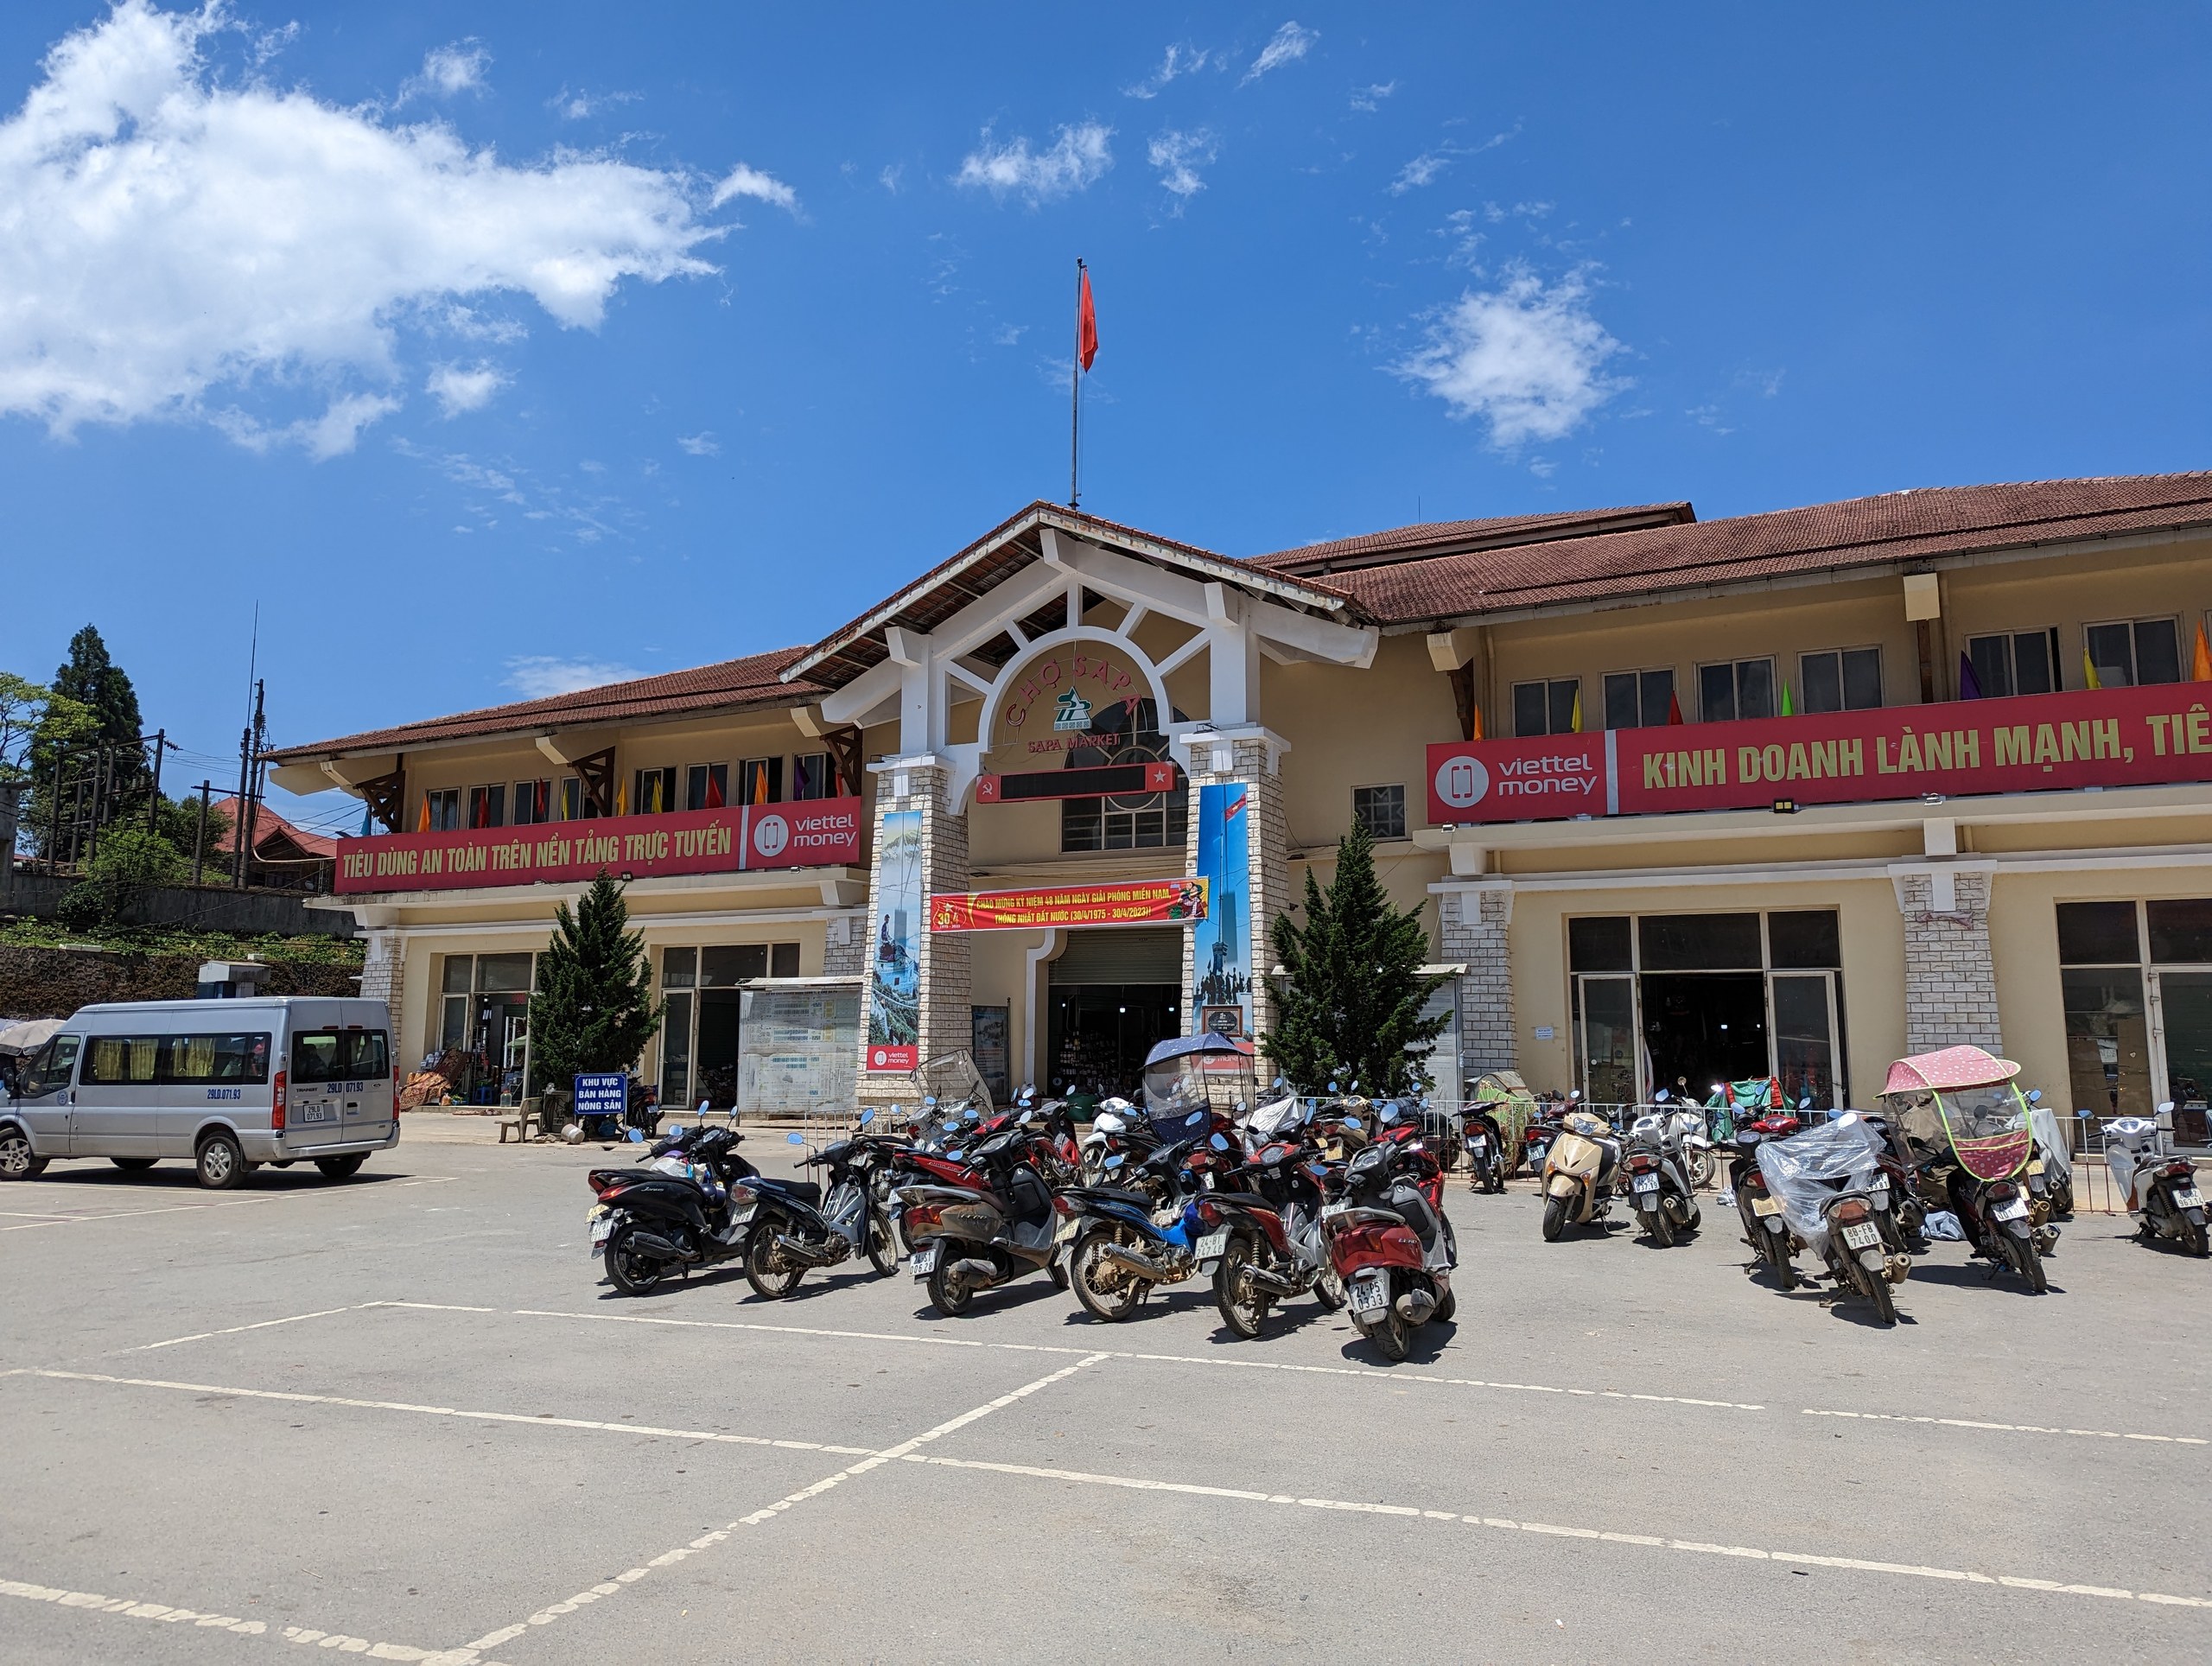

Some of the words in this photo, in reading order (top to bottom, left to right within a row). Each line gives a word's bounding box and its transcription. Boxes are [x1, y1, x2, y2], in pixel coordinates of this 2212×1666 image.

[1005, 658, 1062, 727] CHỢ
[1072, 653, 1142, 716] SAPA
[1027, 738, 1063, 754] SAPA
[1067, 733, 1121, 749] MARKET
[1643, 748, 1726, 789] KINH
[1738, 738, 1865, 784] DOANH
[1876, 726, 1980, 774] LÀNH
[1993, 718, 2134, 773] MẠNH,
[1497, 754, 1593, 776] viettel
[1498, 775, 1598, 796] money
[794, 813, 855, 831] viettel
[793, 830, 857, 848] money
[343, 849, 374, 878] TIÊU
[377, 846, 418, 876] DÙNG
[421, 849, 443, 874] AN
[447, 842, 487, 873] TOÀN
[491, 838, 532, 870] TRÊN
[536, 832, 571, 868] NỀN
[575, 829, 620, 864] TẢNG
[625, 829, 669, 865] TRỰC
[674, 819, 732, 858] TUYẾN
[1071, 909, 1106, 922] (30/4/1975
[327, 1083, 342, 1093] 29LD
[601, 1078, 618, 1087] VỰC
[579, 1089, 596, 1098] BÁN
[598, 1089, 621, 1098] HÀNG
[578, 1101, 601, 1110] NÔNG
[603, 1099, 621, 1110] SẢN
[1200, 1236, 1221, 1247] 24-B1
[1851, 1233, 1878, 1248] 7400
[1196, 1244, 1224, 1258] 247.46
[1355, 1281, 1381, 1296] 24-P5
[1358, 1294, 1383, 1311] 0333
